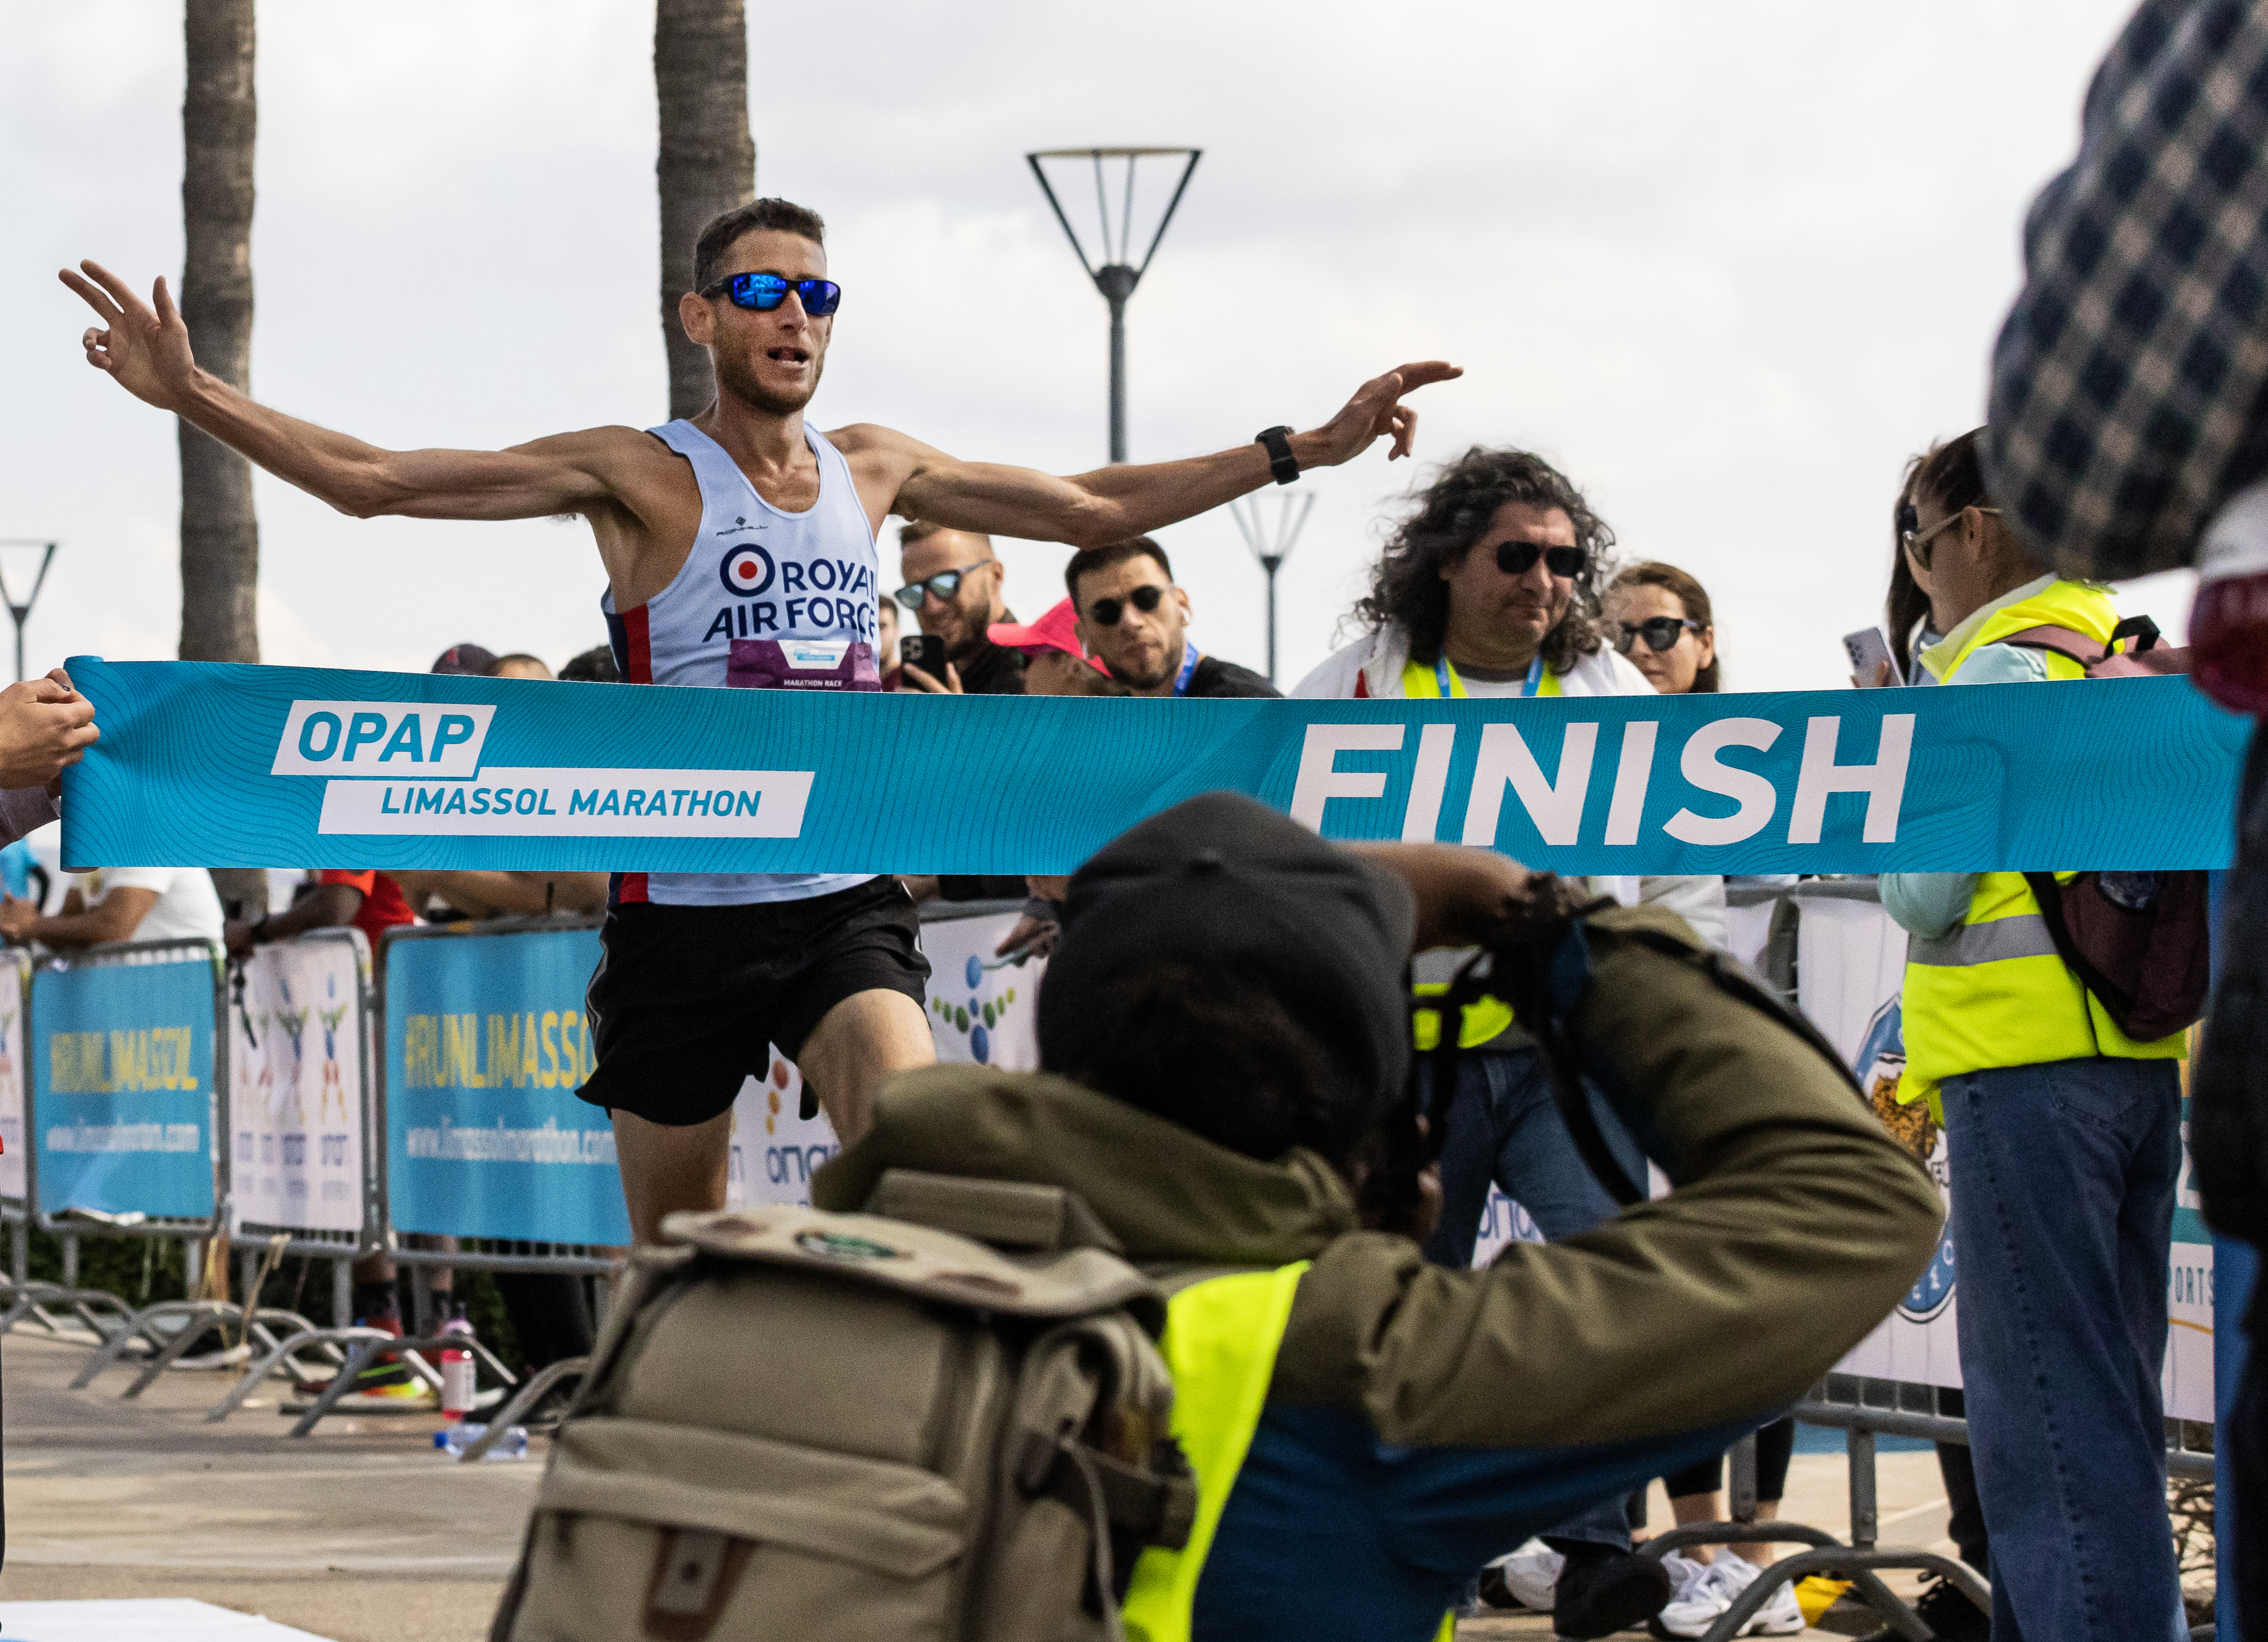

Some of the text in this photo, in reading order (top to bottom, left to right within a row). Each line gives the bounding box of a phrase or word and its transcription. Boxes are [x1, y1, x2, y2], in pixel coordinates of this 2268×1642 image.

[781, 558, 874, 602] ROYAL
[702, 597, 875, 643] AIR FORCE
[298, 711, 475, 763] OPAP
[382, 787, 762, 817] LIMASSOL MARATHON
[1288, 713, 1916, 846] FINISH
